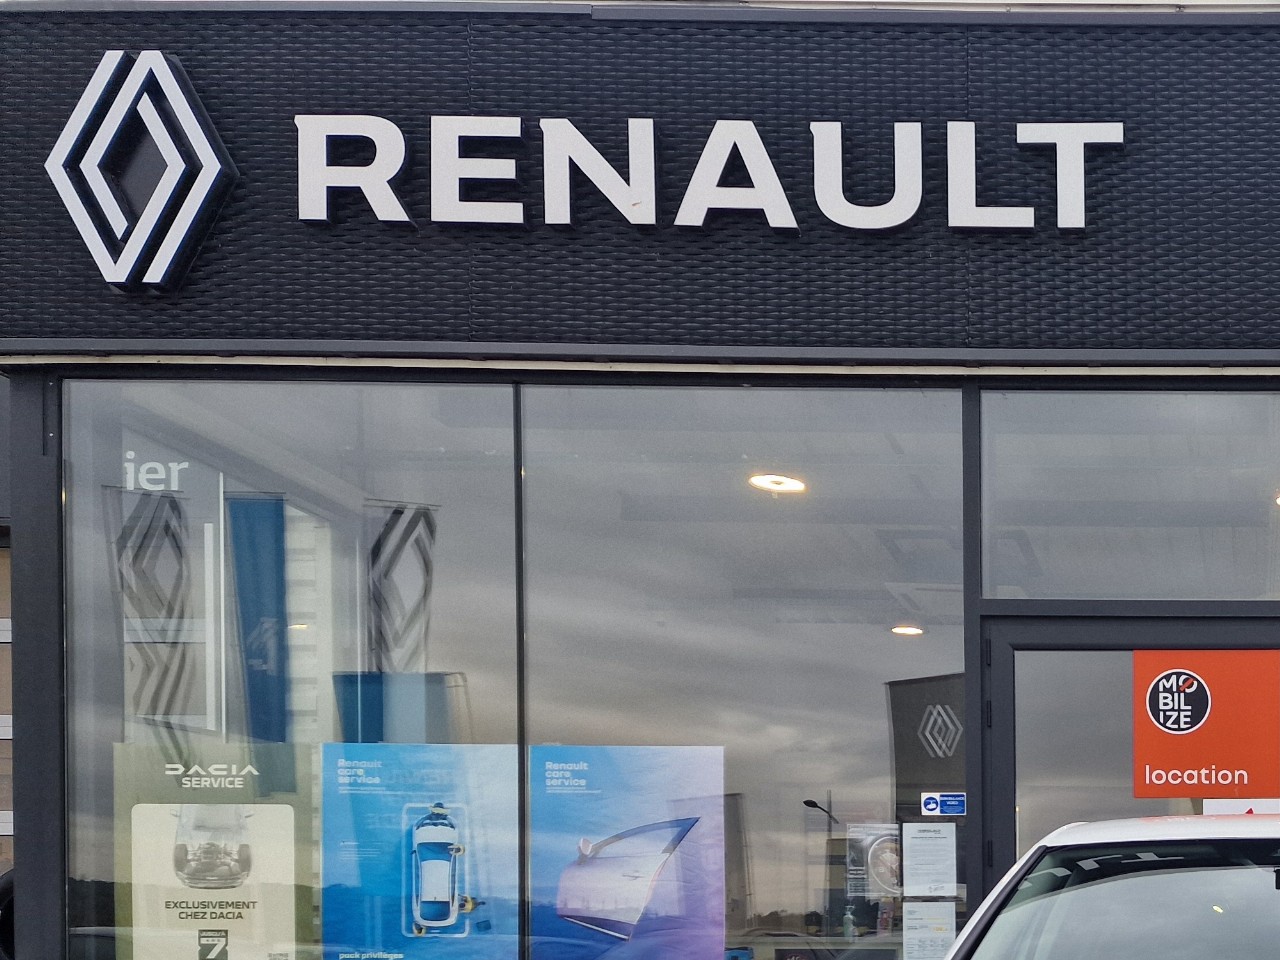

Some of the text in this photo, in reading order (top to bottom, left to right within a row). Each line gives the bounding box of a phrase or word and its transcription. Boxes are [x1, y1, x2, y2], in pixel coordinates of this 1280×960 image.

[293, 113, 1125, 230] RENAULT
[337, 759, 382, 768] Renault
[545, 761, 589, 770] Renault
[165, 764, 260, 775] DACIA
[545, 770, 571, 778] care
[1145, 764, 1249, 785] location
[181, 777, 244, 788] SERVICE
[545, 778, 587, 786] service
[164, 900, 258, 910] EXCLUSIVEMENT
[178, 911, 244, 920] CHEZ DACIA
[200, 937, 226, 959] 7
